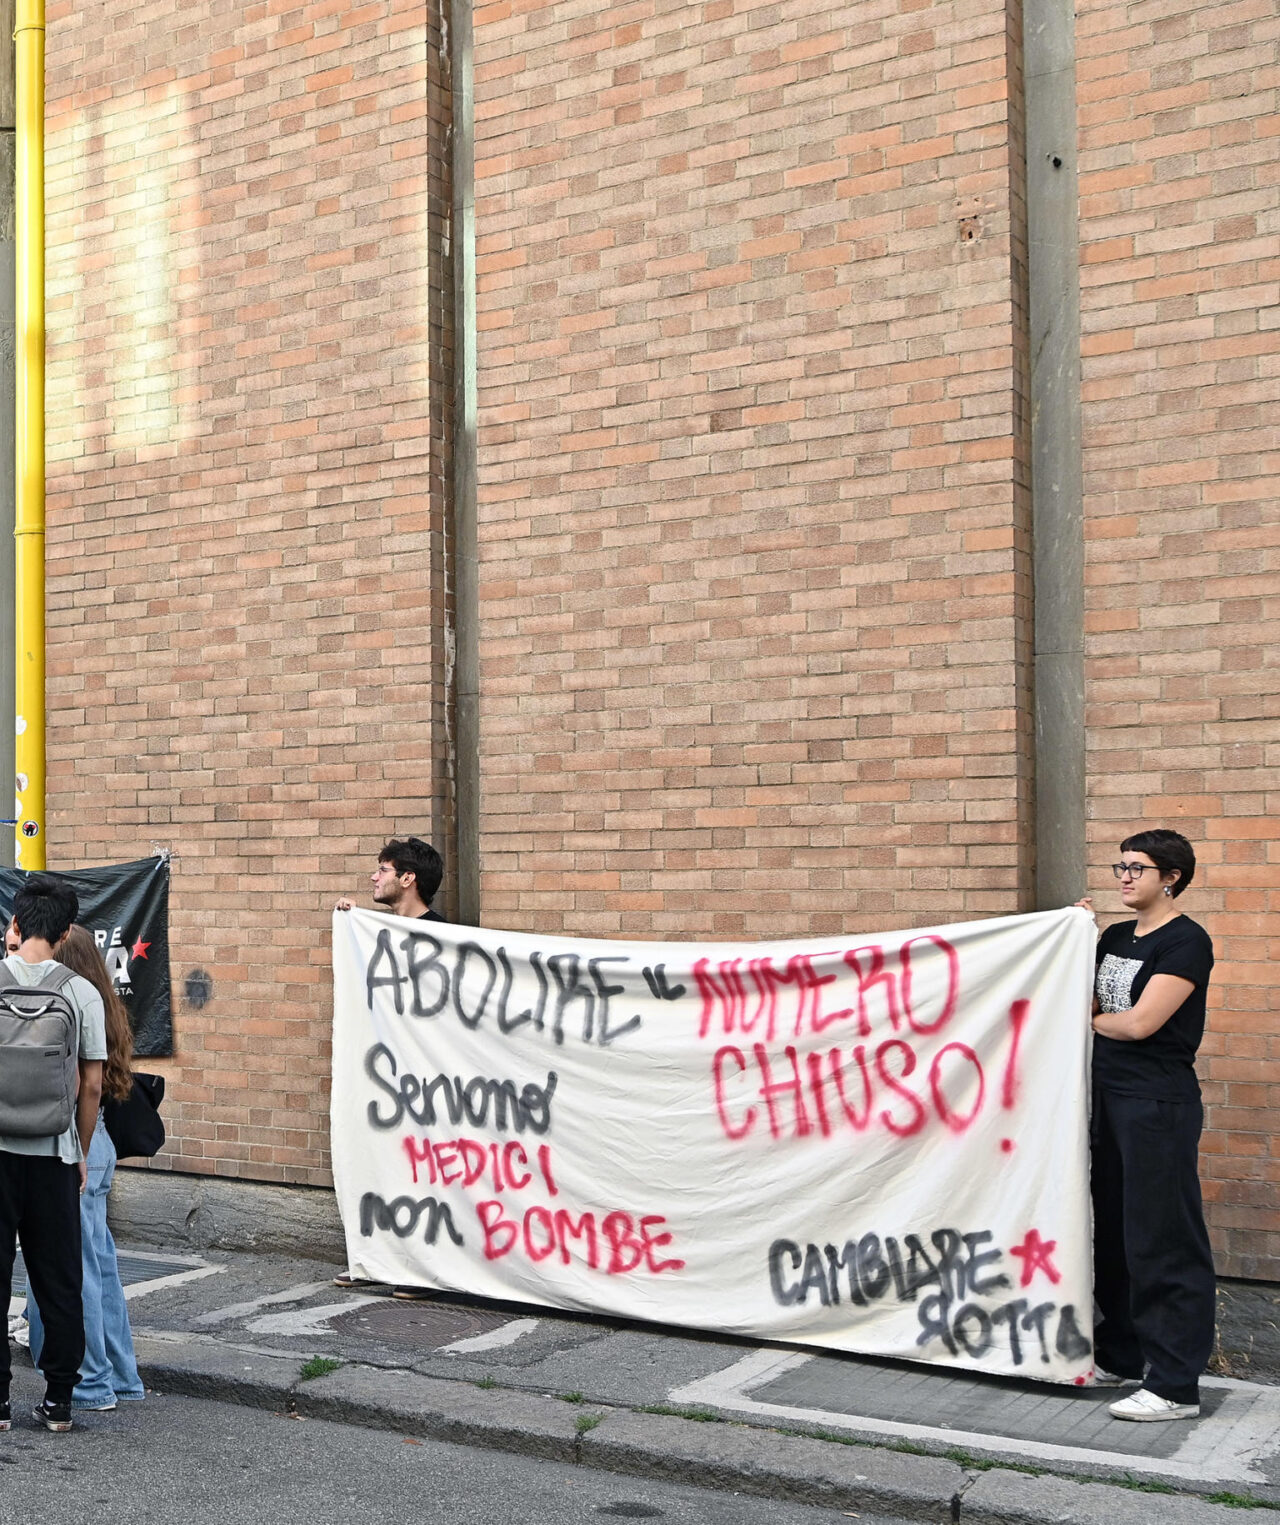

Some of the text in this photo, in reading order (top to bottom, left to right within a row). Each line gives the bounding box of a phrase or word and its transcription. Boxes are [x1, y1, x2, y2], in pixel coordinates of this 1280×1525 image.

[367, 928, 960, 1046] ABOLIRE IL NUMERO
[365, 1041, 558, 1135] Servono
[711, 998, 1031, 1153] CHIUSO!
[402, 1134, 559, 1196] MEDICI
[359, 1191, 686, 1275] non BOMBE
[768, 1227, 1014, 1308] CAMBIARE
[915, 1294, 1094, 1366] ROTTA
